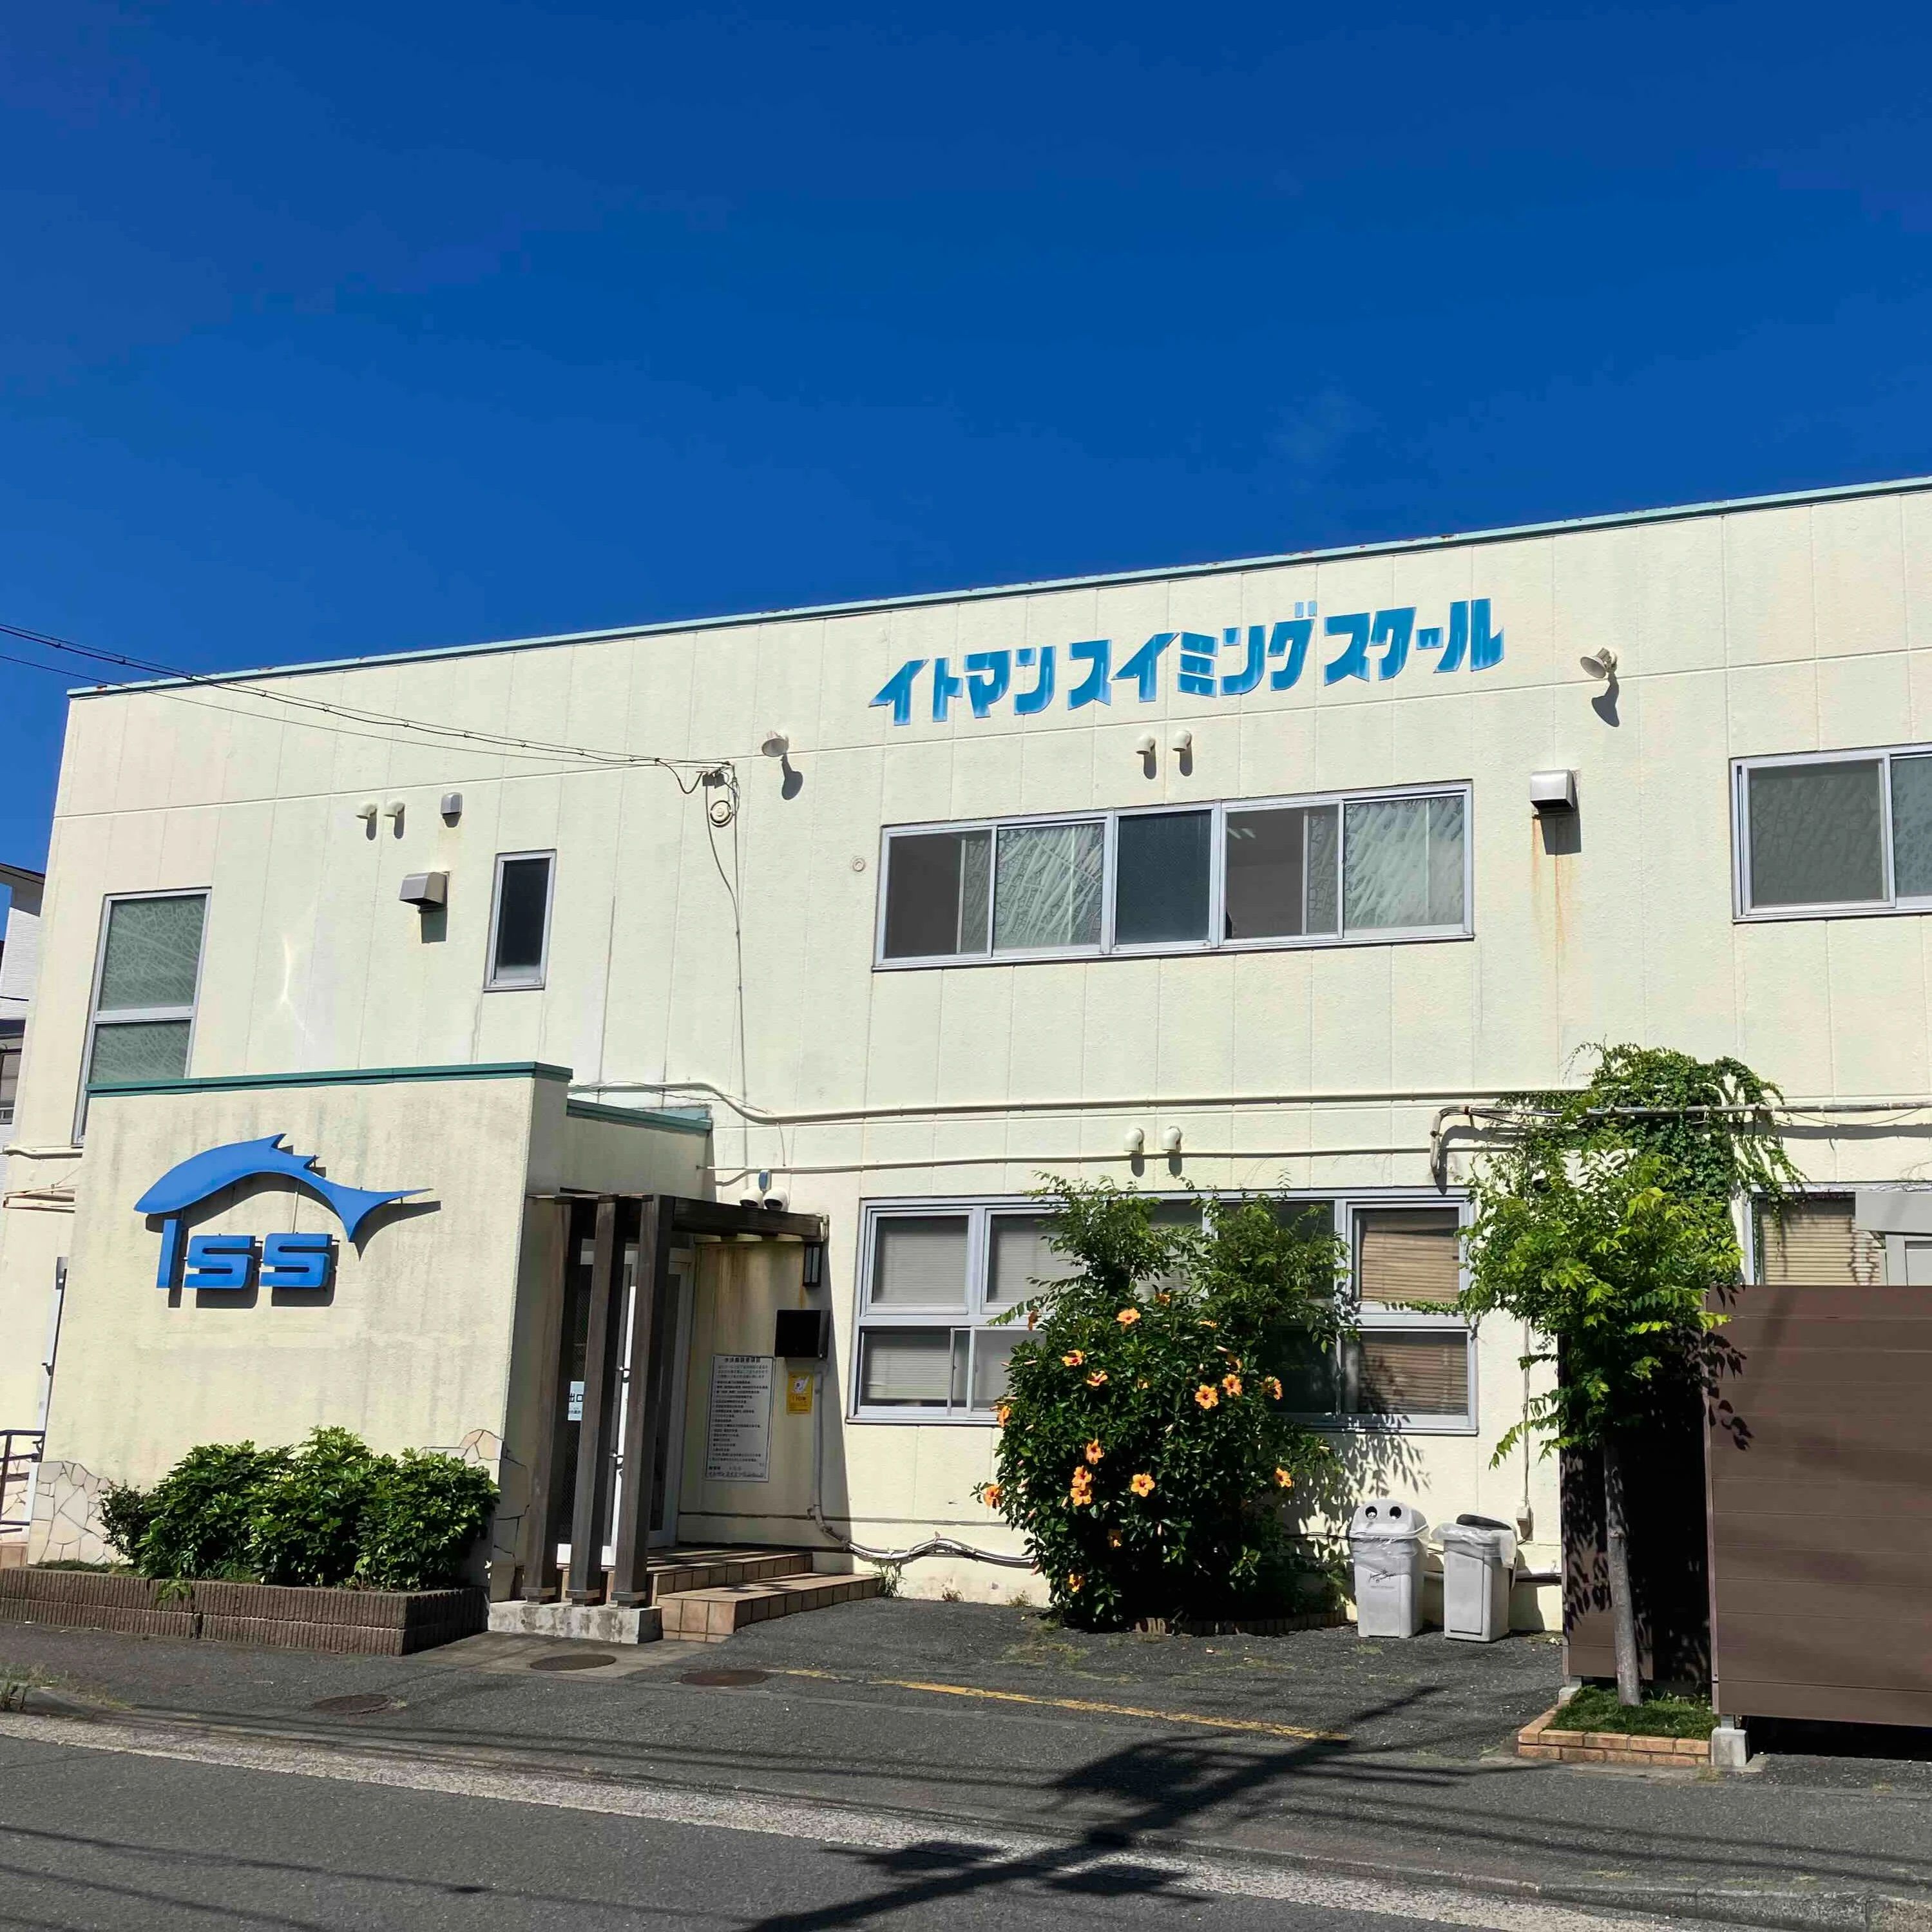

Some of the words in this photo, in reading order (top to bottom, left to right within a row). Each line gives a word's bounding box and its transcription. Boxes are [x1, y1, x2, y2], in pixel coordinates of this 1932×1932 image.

[869, 598, 1504, 726] イトマンスイミングスクール
[157, 1218, 333, 1289] ISS
